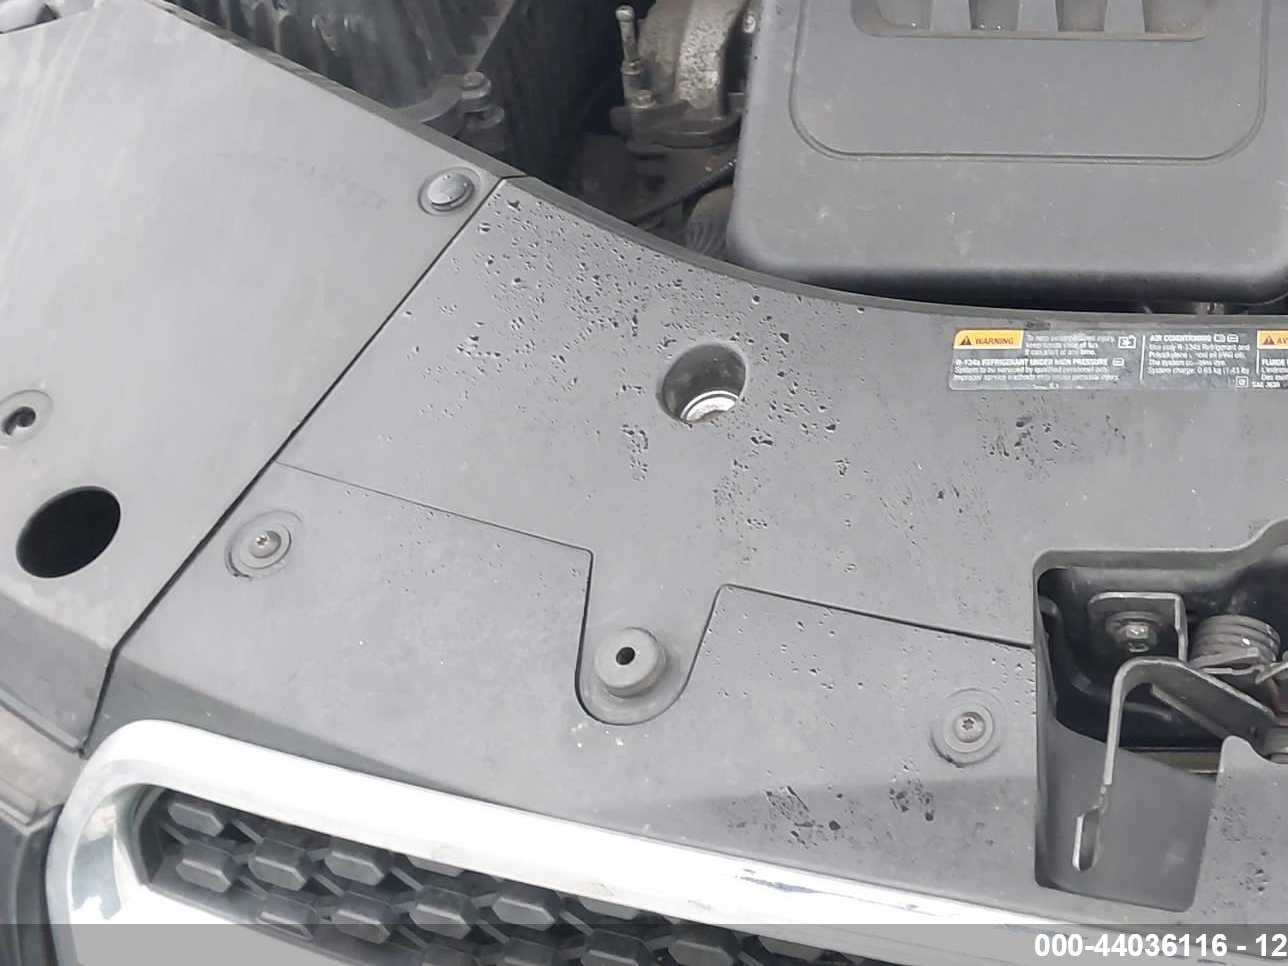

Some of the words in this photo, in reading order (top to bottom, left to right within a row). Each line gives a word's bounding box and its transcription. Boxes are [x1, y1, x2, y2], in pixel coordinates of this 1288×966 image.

[975, 337, 1014, 345] WARNING
[1150, 334, 1162, 342] AIR
[1163, 334, 1212, 342] CONDITIONING
[981, 358, 1029, 366] REFRIGERANT
[1030, 358, 1054, 366] UNDER
[1073, 358, 1108, 366] PRESSURE
[1261, 358, 1286, 366] FLUIDE
